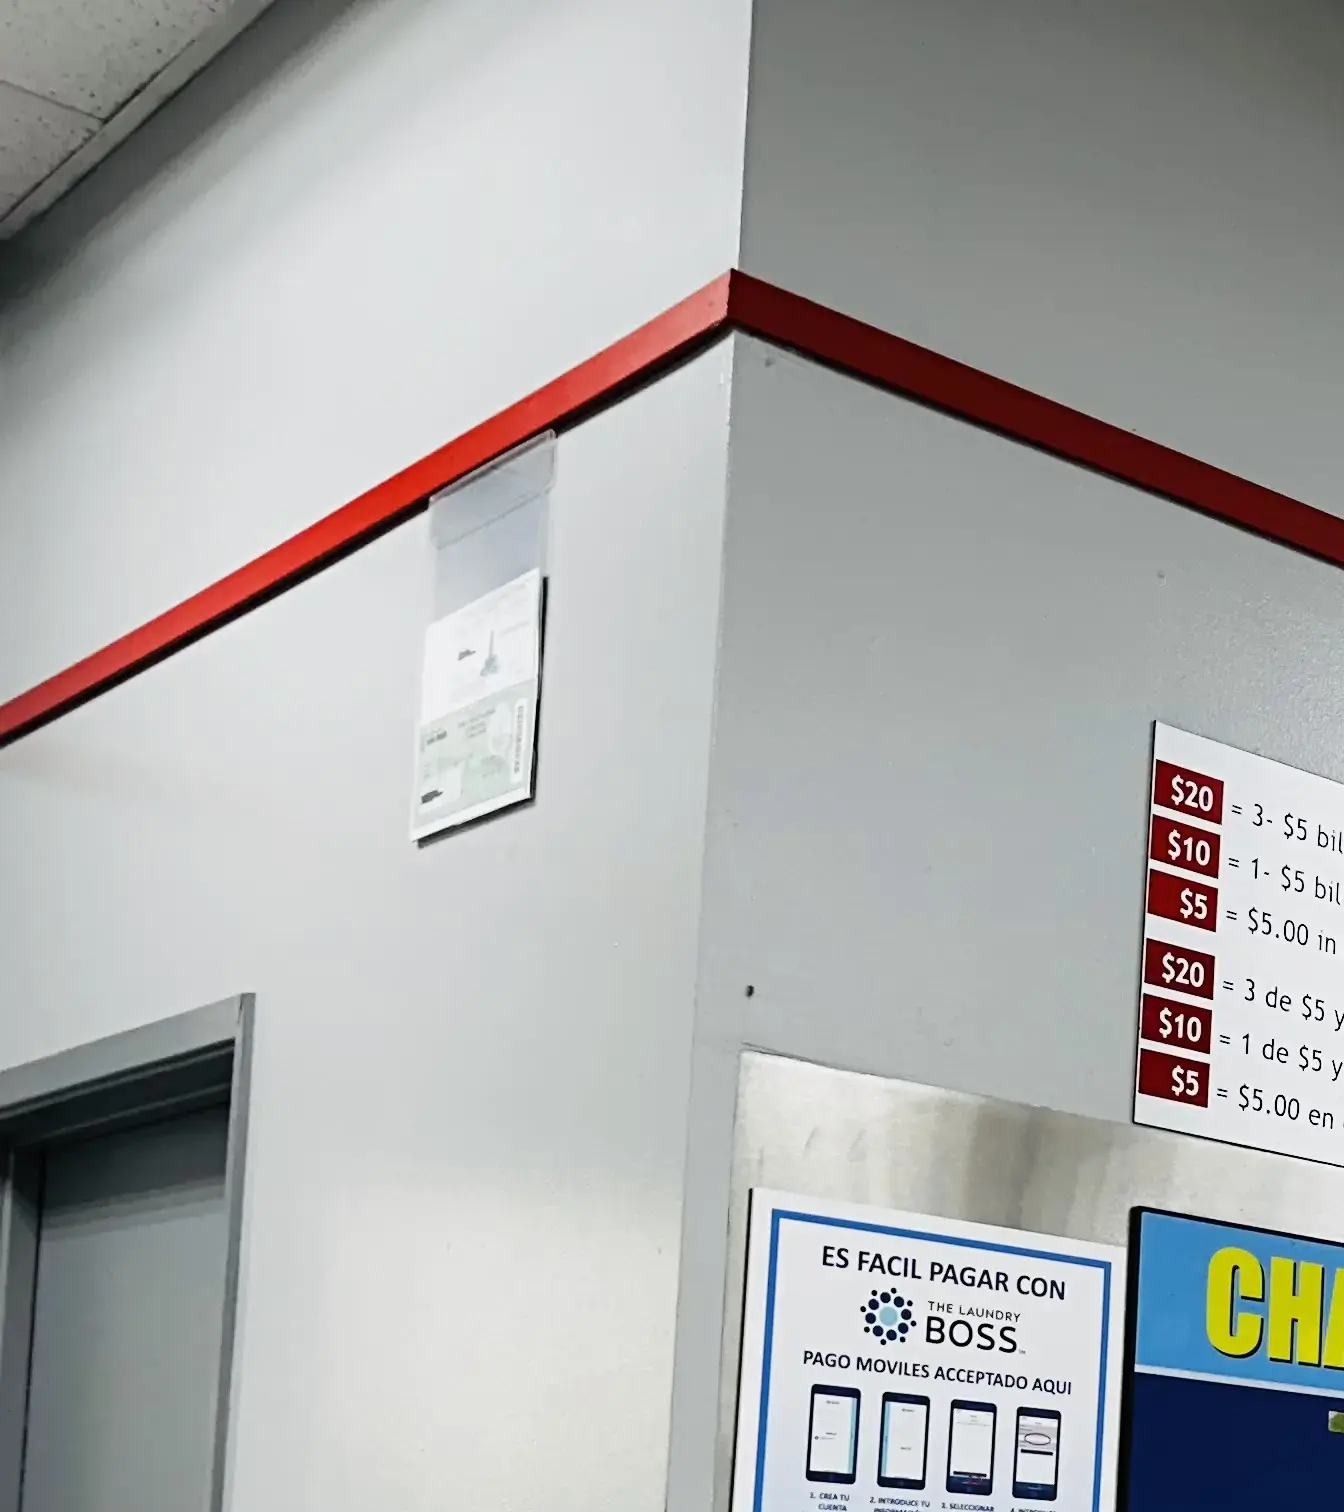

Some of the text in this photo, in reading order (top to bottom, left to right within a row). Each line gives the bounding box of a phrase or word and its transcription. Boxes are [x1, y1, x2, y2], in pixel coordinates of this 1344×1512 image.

[1171, 775, 1213, 811] $20
[1253, 804, 1272, 826] 3-
[1284, 813, 1307, 840] $5
[1168, 829, 1210, 865] $10
[1252, 858, 1269, 879] 1-
[1282, 865, 1304, 892] $5
[1180, 888, 1207, 919] $5
[1248, 907, 1308, 945] $5.00
[1317, 930, 1336, 954] in
[1162, 952, 1204, 987] $20
[1245, 979, 1254, 1001] 3
[1266, 986, 1291, 1012] de
[1302, 994, 1324, 1021] $5
[1335, 1010, 1344, 1031] y
[1159, 1008, 1201, 1042] $10
[1243, 1033, 1249, 1054] 1
[1263, 1039, 1288, 1063] de
[1299, 1045, 1321, 1071] $5
[1332, 1060, 1343, 1081] y
[1172, 1065, 1198, 1096] $5
[1239, 1083, 1299, 1120] $5.00
[1309, 1109, 1333, 1129] en
[822, 1245, 1065, 1300] ES FACIL PAGAR CON
[926, 1316, 1017, 1353] BOSS
[928, 1301, 1021, 1322] THE LAUNDRY
[804, 1350, 1071, 1395] PAGO MOVILES ACCEPTADO AQUI
